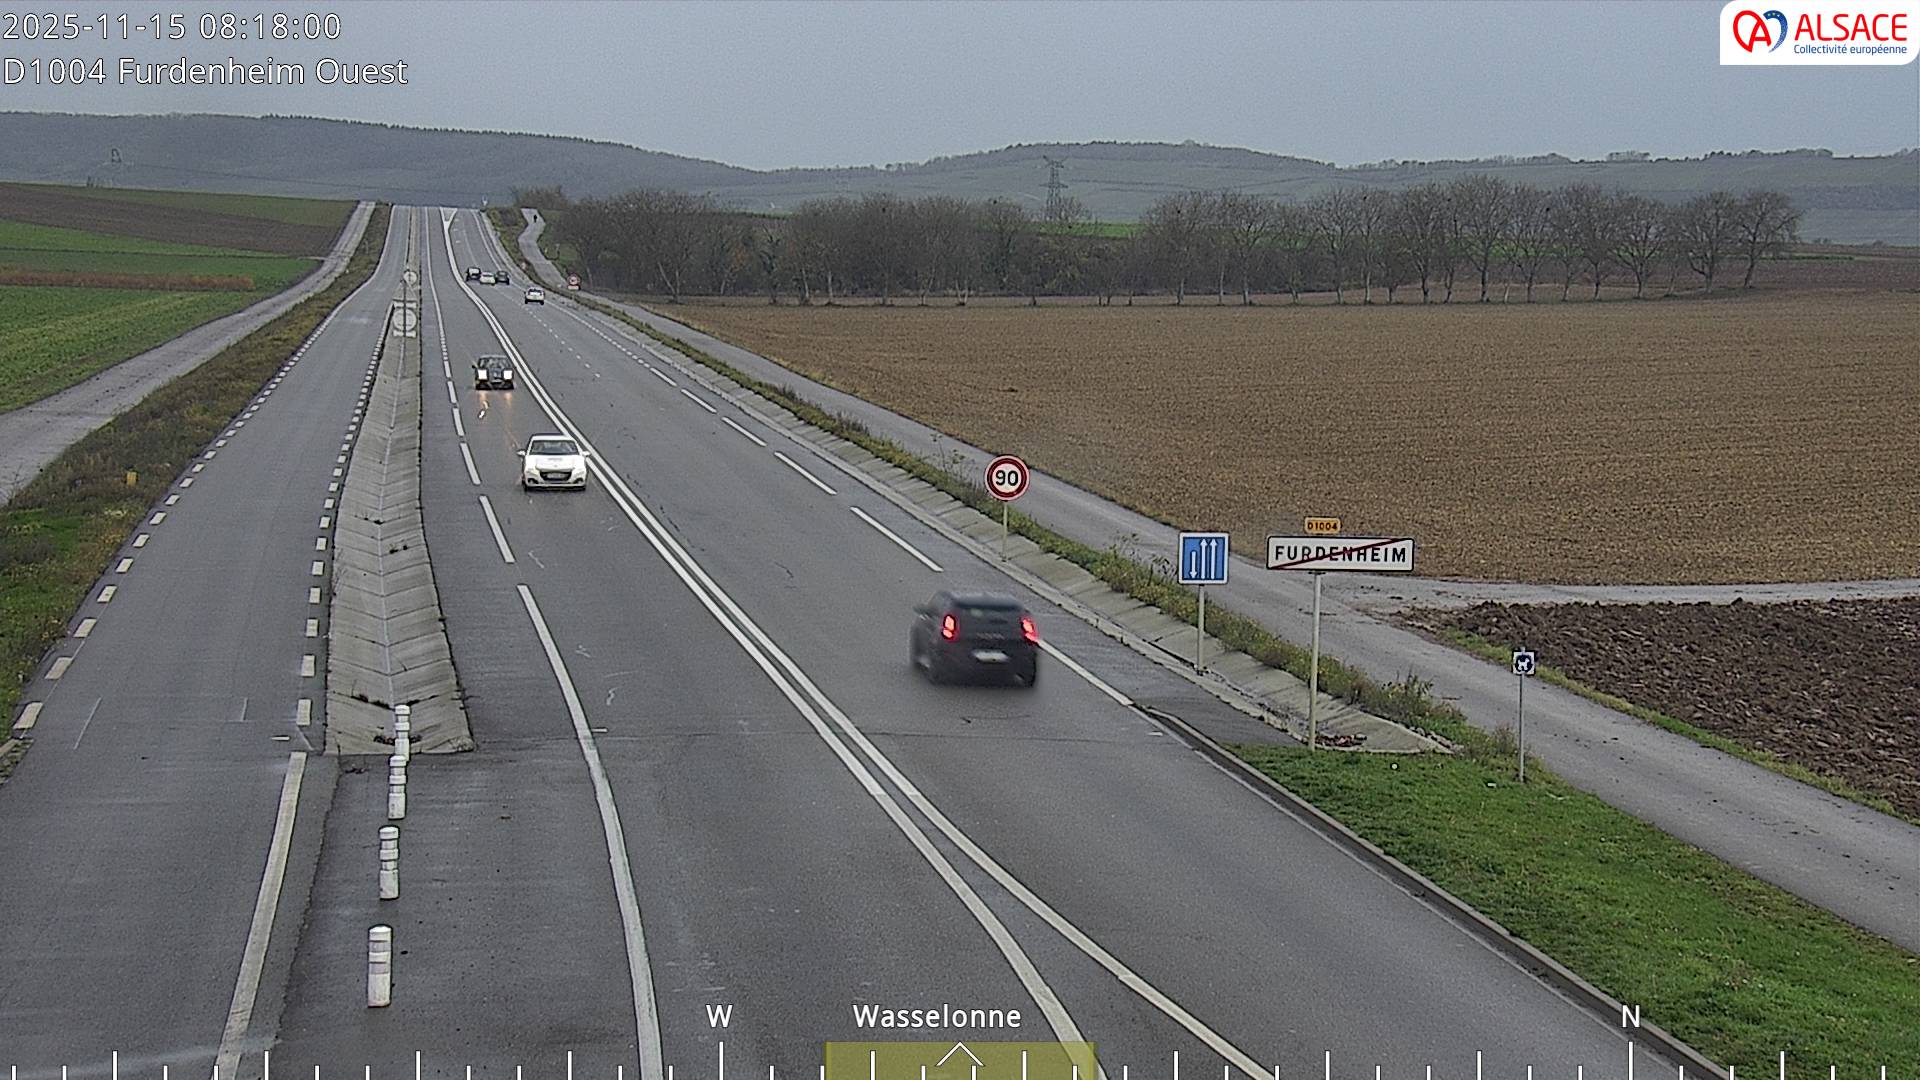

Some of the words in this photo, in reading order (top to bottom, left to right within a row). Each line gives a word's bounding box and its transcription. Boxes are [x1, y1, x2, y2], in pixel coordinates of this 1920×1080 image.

[995, 469, 1019, 487] 90
[1307, 521, 1338, 531] D1004
[1274, 545, 1407, 563] FURDENHEIM
